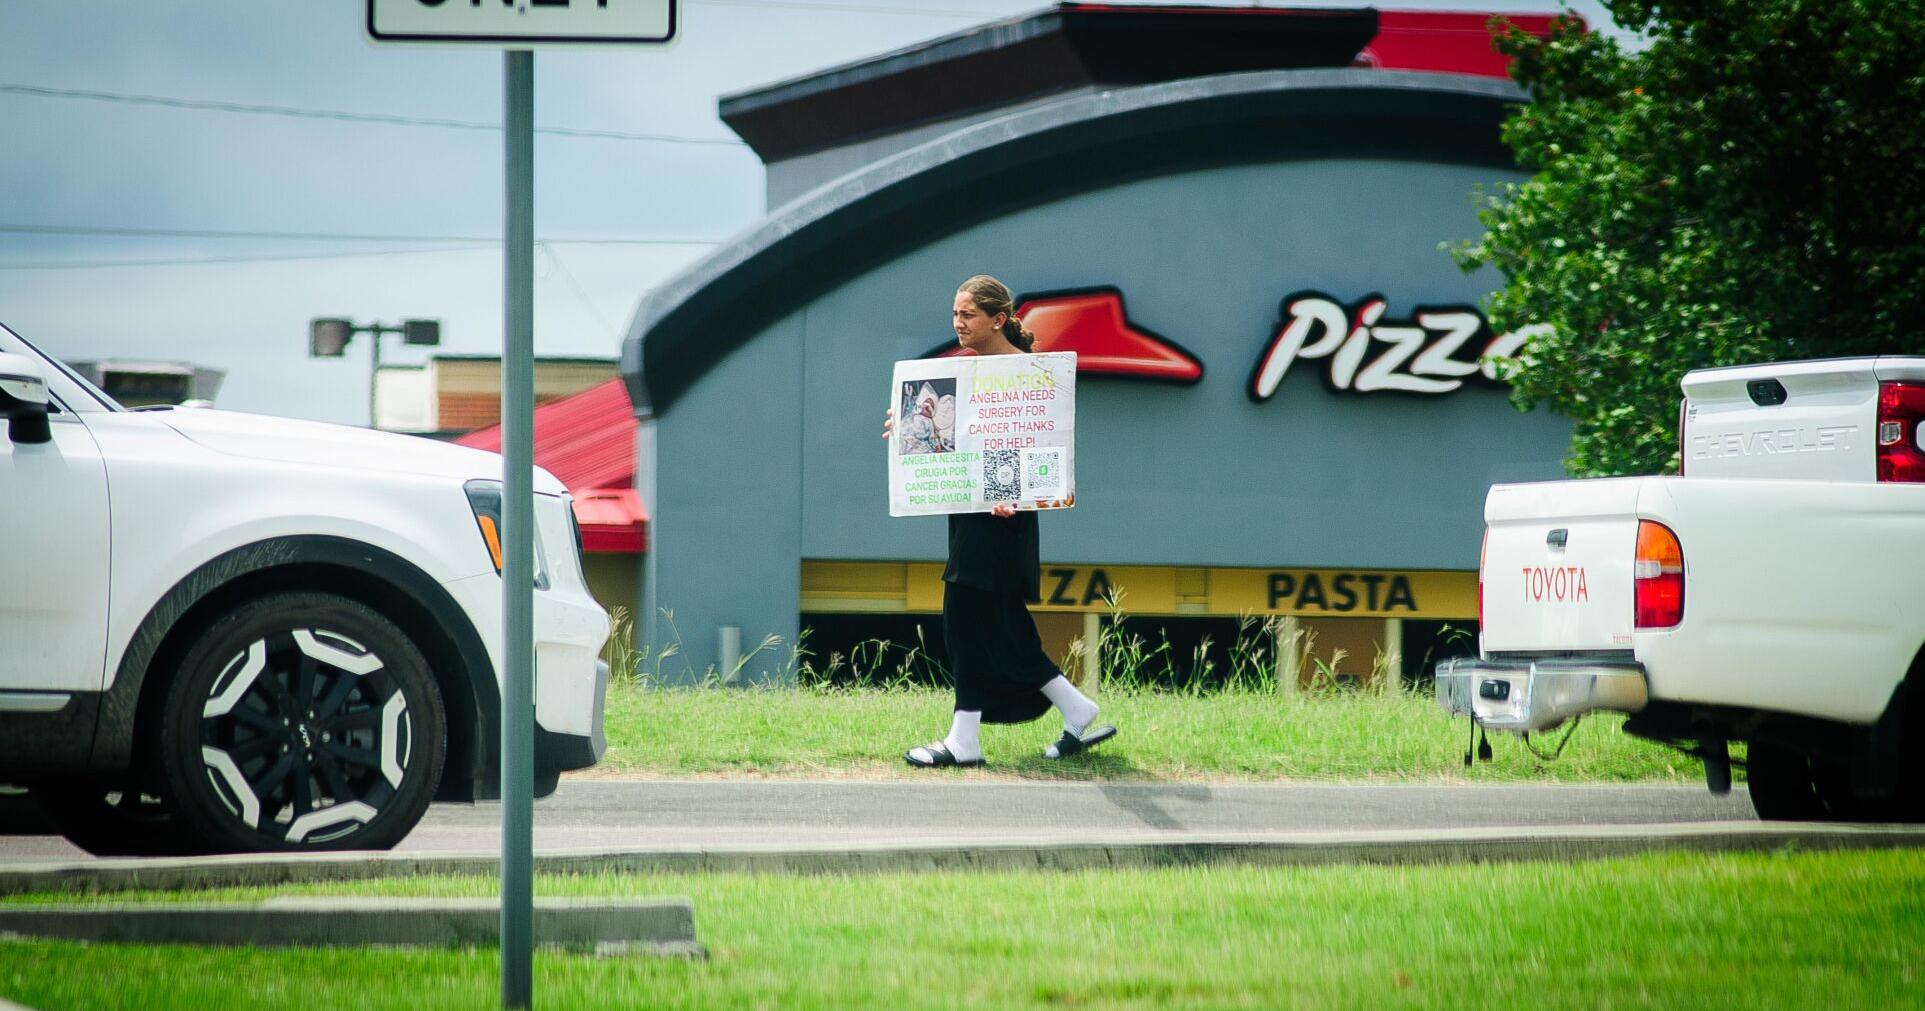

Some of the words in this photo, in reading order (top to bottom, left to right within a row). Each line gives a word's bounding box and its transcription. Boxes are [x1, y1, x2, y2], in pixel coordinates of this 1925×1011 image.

[969, 391, 1020, 404] ANGELINA
[1022, 389, 1056, 401] NEEDS
[978, 406, 1023, 419] SURGERY
[1025, 405, 1046, 417] FOR
[968, 423, 1010, 435] CANCER
[1012, 420, 1055, 432] THANKS
[984, 438, 1004, 450] FOR
[1006, 437, 1036, 449] HELP!
[1692, 424, 1859, 460] CHEVROLET
[939, 452, 980, 463] NECESITA
[914, 468, 948, 478] CIRUGIA
[949, 466, 968, 477] POR
[905, 481, 938, 492] CANCER
[940, 479, 977, 490] GRACIAS
[909, 495, 926, 505] POR
[927, 494, 940, 504] SU
[1522, 567, 1589, 603] TOYOTA
[1266, 573, 1418, 612] PASTA
